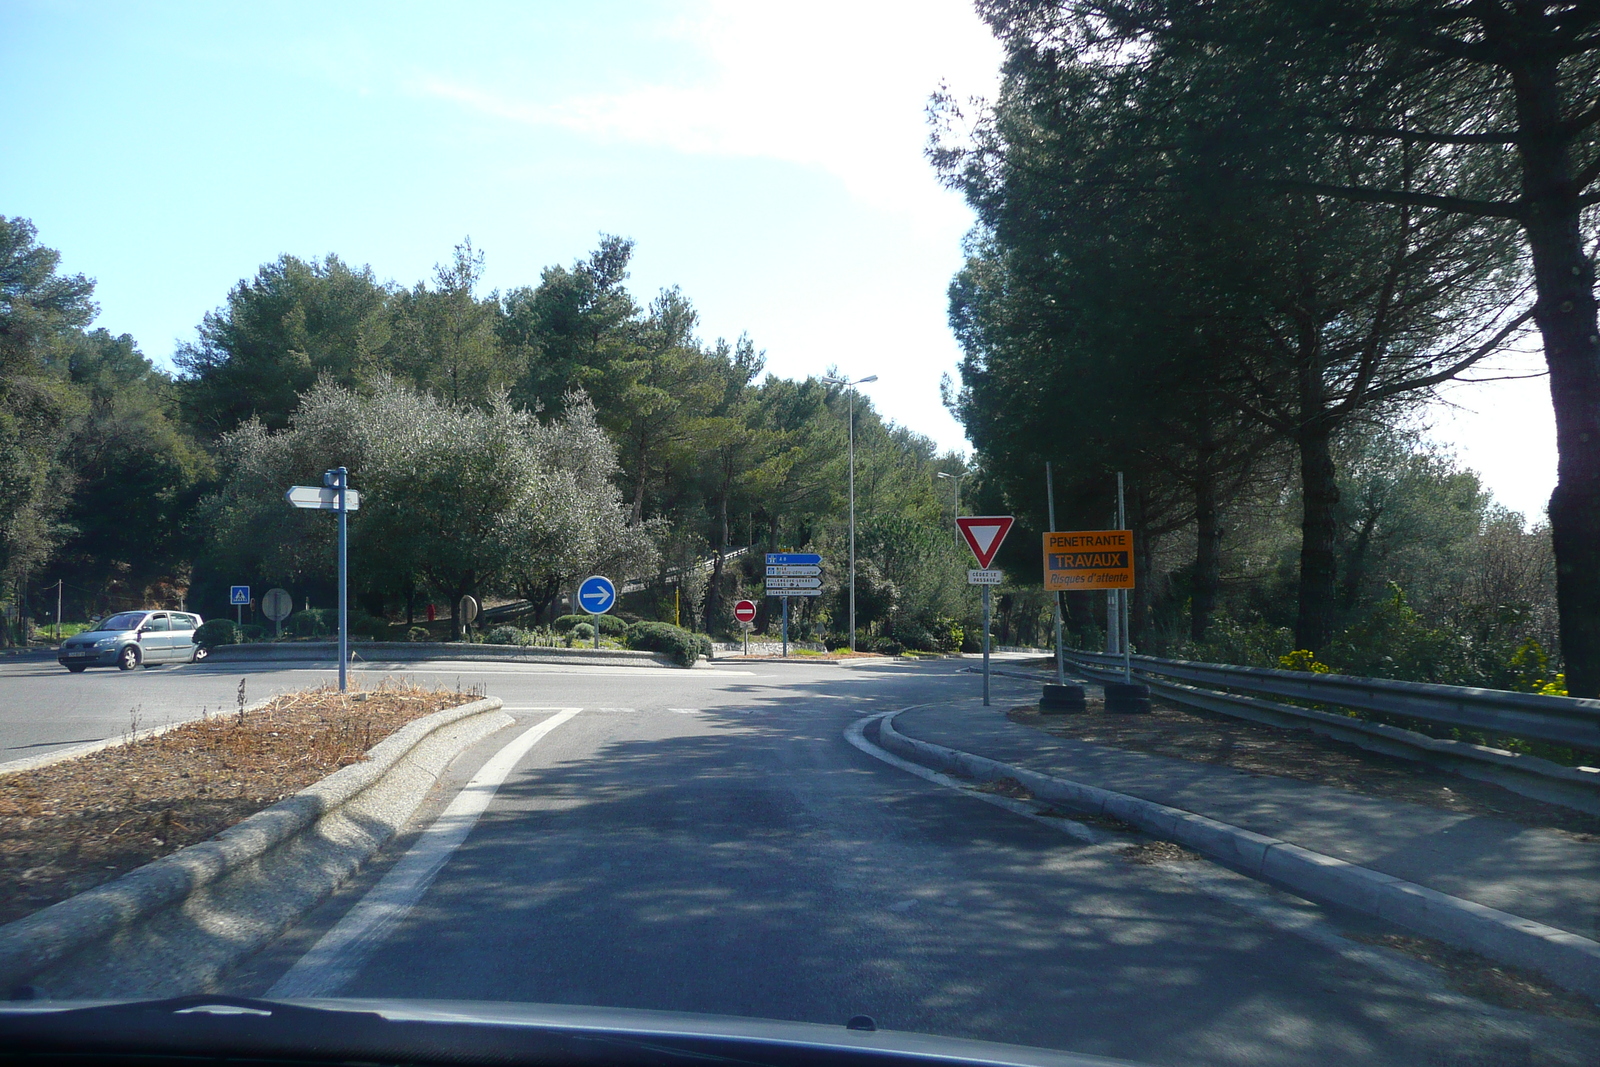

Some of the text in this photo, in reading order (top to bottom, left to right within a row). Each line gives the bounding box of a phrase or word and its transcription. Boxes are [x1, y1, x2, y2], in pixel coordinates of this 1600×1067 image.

[1050, 535, 1126, 547] PENETRANTE
[1055, 554, 1121, 568] TRAVAUX
[1050, 572, 1128, 586] Risques d'attente
